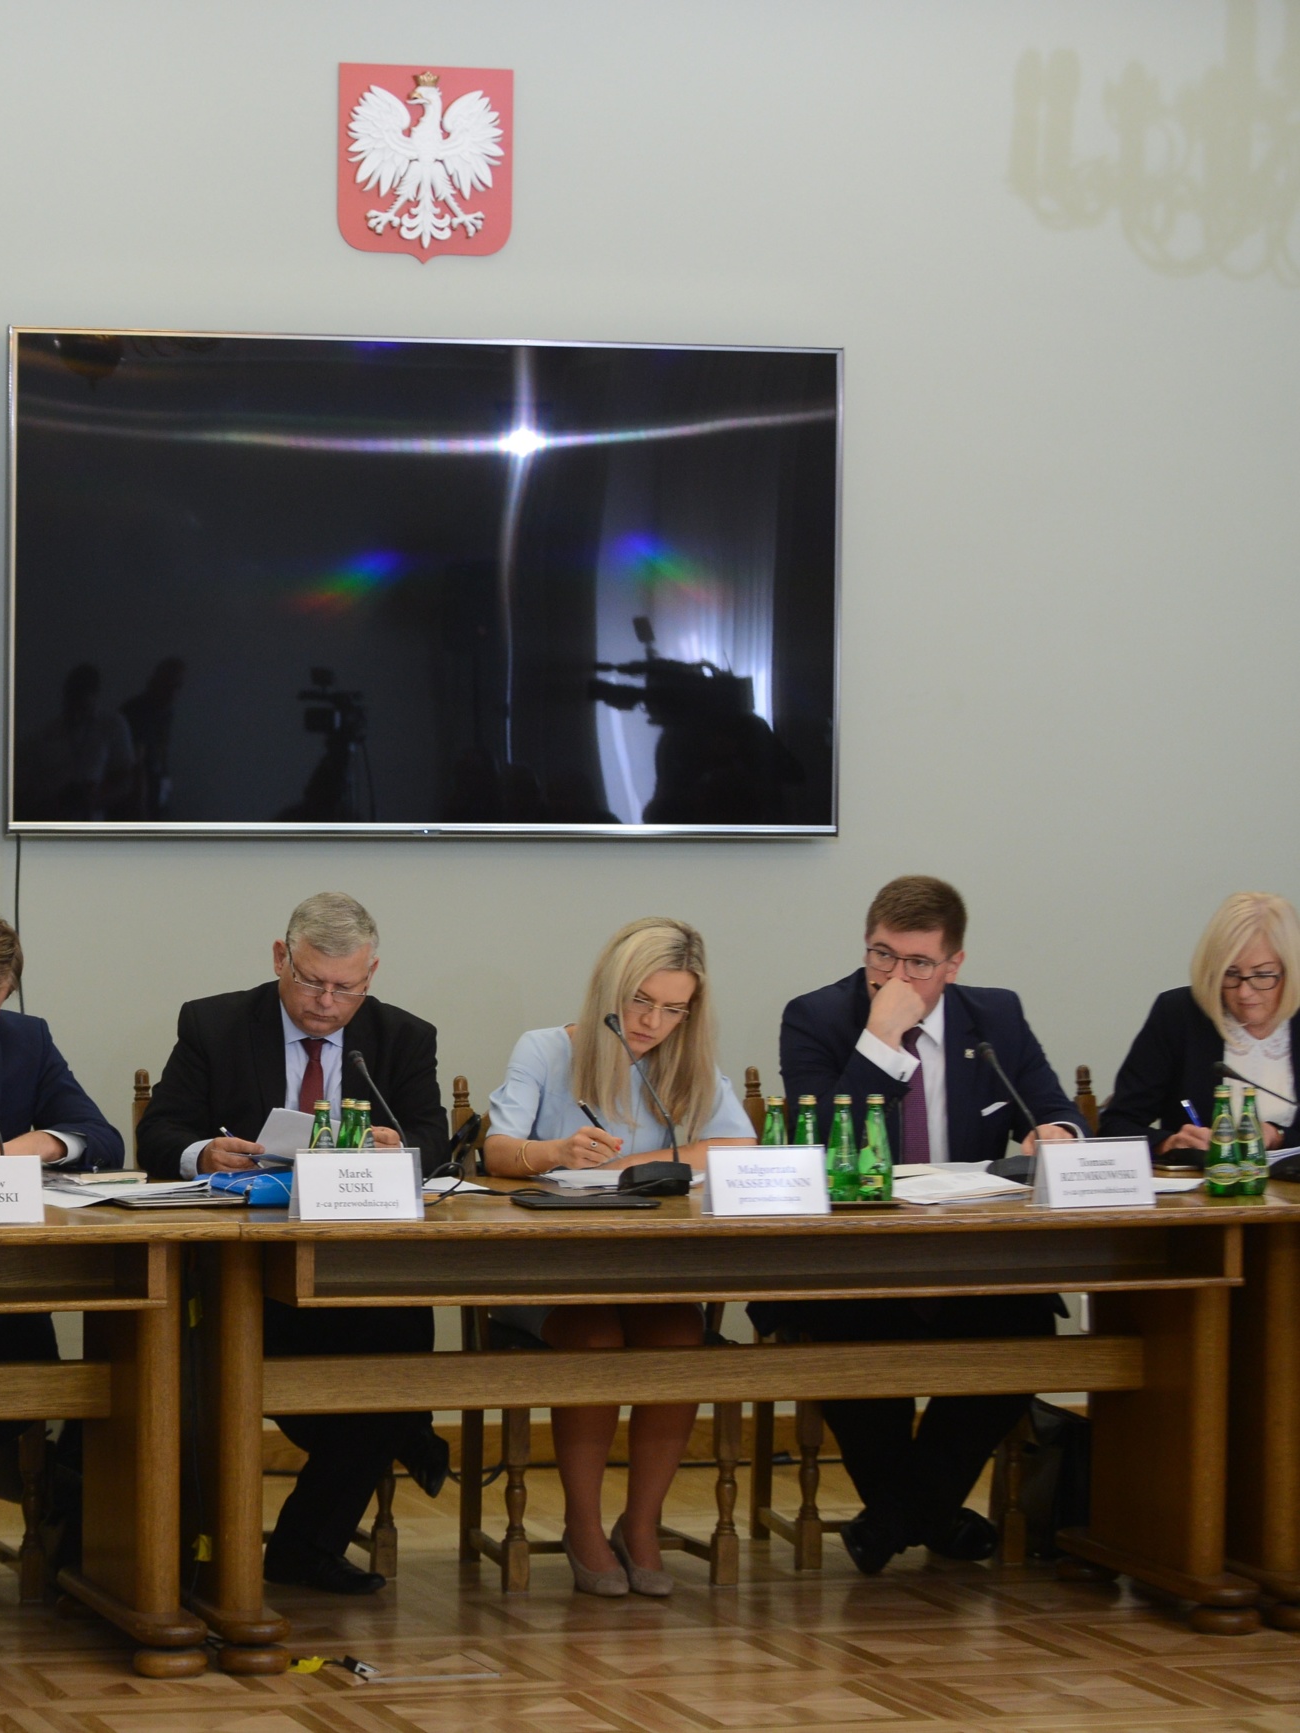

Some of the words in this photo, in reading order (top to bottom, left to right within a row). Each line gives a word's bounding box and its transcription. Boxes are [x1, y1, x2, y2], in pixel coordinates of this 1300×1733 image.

[338, 1168, 373, 1179] Marek
[338, 1182, 374, 1193] SUSKI
[726, 1177, 812, 1189] WASSERMANN
